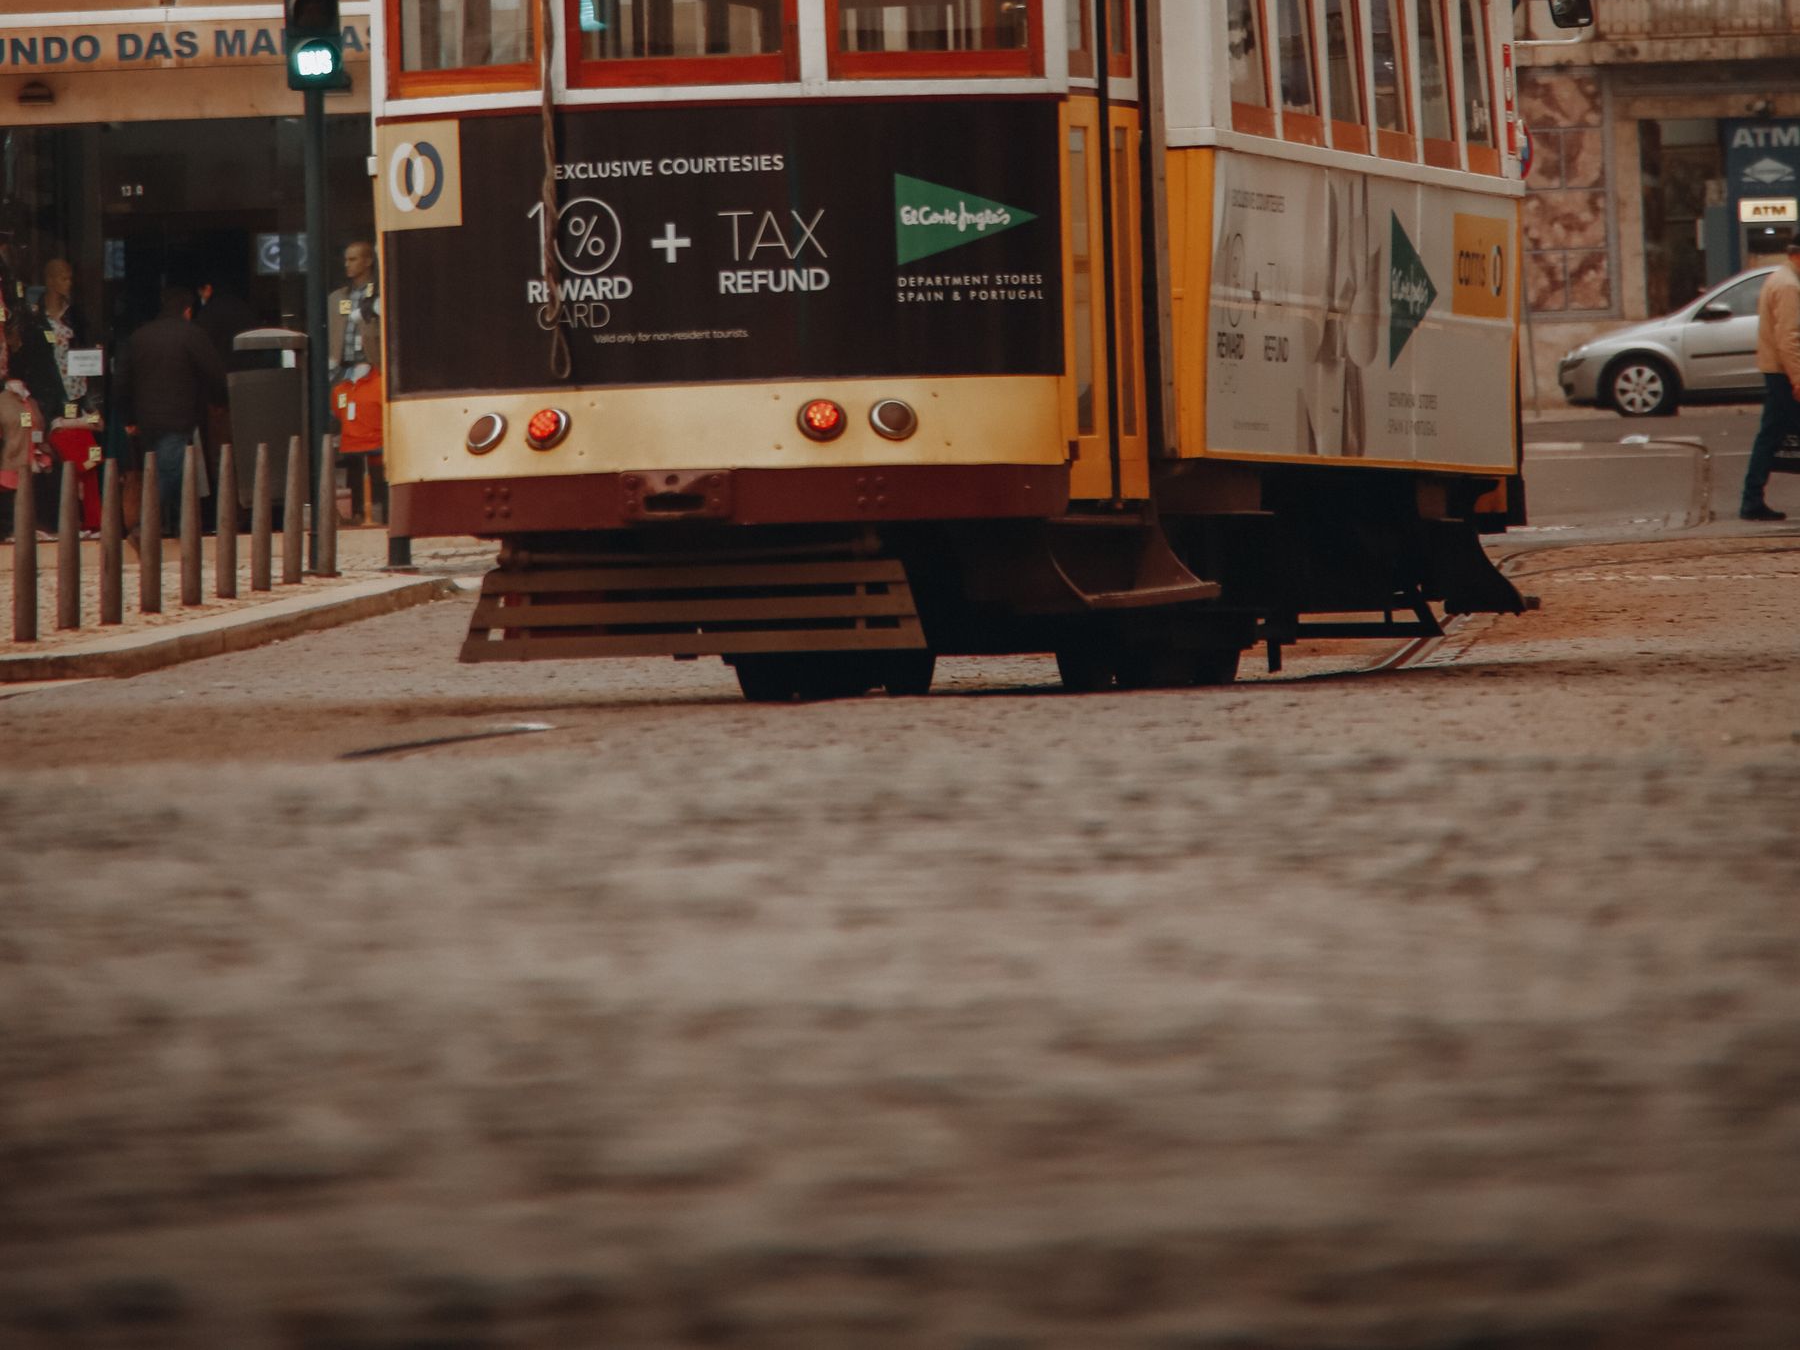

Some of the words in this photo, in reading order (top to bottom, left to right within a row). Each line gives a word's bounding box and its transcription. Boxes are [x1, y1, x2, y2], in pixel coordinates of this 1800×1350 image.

[0, 34, 101, 66] NDO
[118, 30, 199, 61] DAS
[214, 25, 370, 57] MAA
[1732, 125, 1800, 149] ATM
[554, 160, 653, 180] EXCLUSIVE
[658, 154, 785, 175] COURTESIES
[1753, 206, 1786, 216] ATM
[717, 209, 828, 261] TAX
[719, 268, 831, 294] REFUND
[897, 275, 989, 287] DEPARTMENT
[995, 274, 1043, 285] STORES
[897, 291, 944, 303] SPAIN
[952, 291, 961, 302] &
[969, 289, 1044, 300] PORTUGAL
[537, 302, 611, 331] CARD
